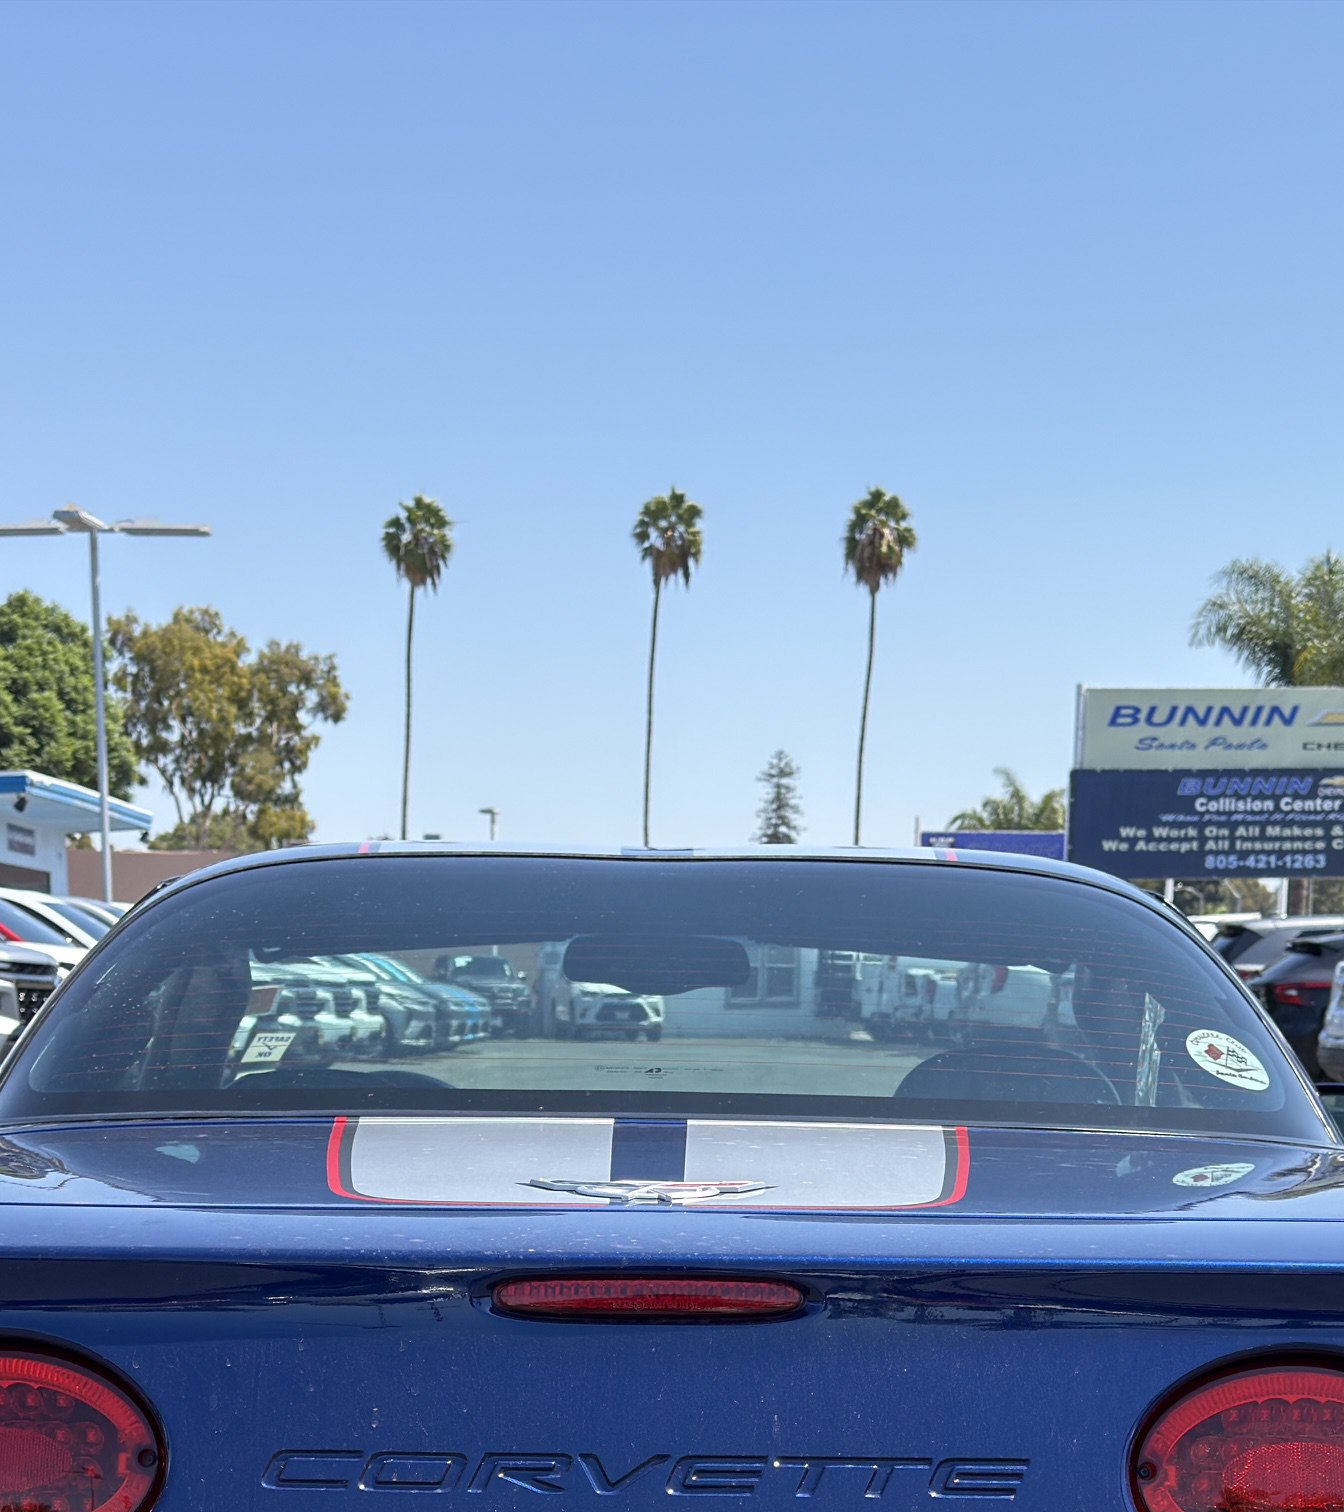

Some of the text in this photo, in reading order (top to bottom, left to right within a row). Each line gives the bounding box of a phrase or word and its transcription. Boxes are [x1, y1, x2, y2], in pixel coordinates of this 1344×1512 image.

[1108, 704, 1299, 727] BUNNIN
[1134, 736, 1268, 751] Santa Paula
[1177, 776, 1313, 796] BUNNIN
[1194, 796, 1343, 812] Collision Center
[1119, 826, 1147, 838] We
[1152, 826, 1198, 838] Work
[1204, 826, 1229, 838] On
[1235, 826, 1260, 837] All
[1265, 825, 1325, 837] Makes
[1331, 825, 1344, 837] &
[1102, 840, 1129, 851] We
[1134, 840, 1199, 853] Accept
[1205, 840, 1229, 850] All
[1235, 839, 1326, 851] Insurance
[1205, 854, 1327, 869] 805-421-1263
[260, 1448, 1031, 1501] CORVETTE
